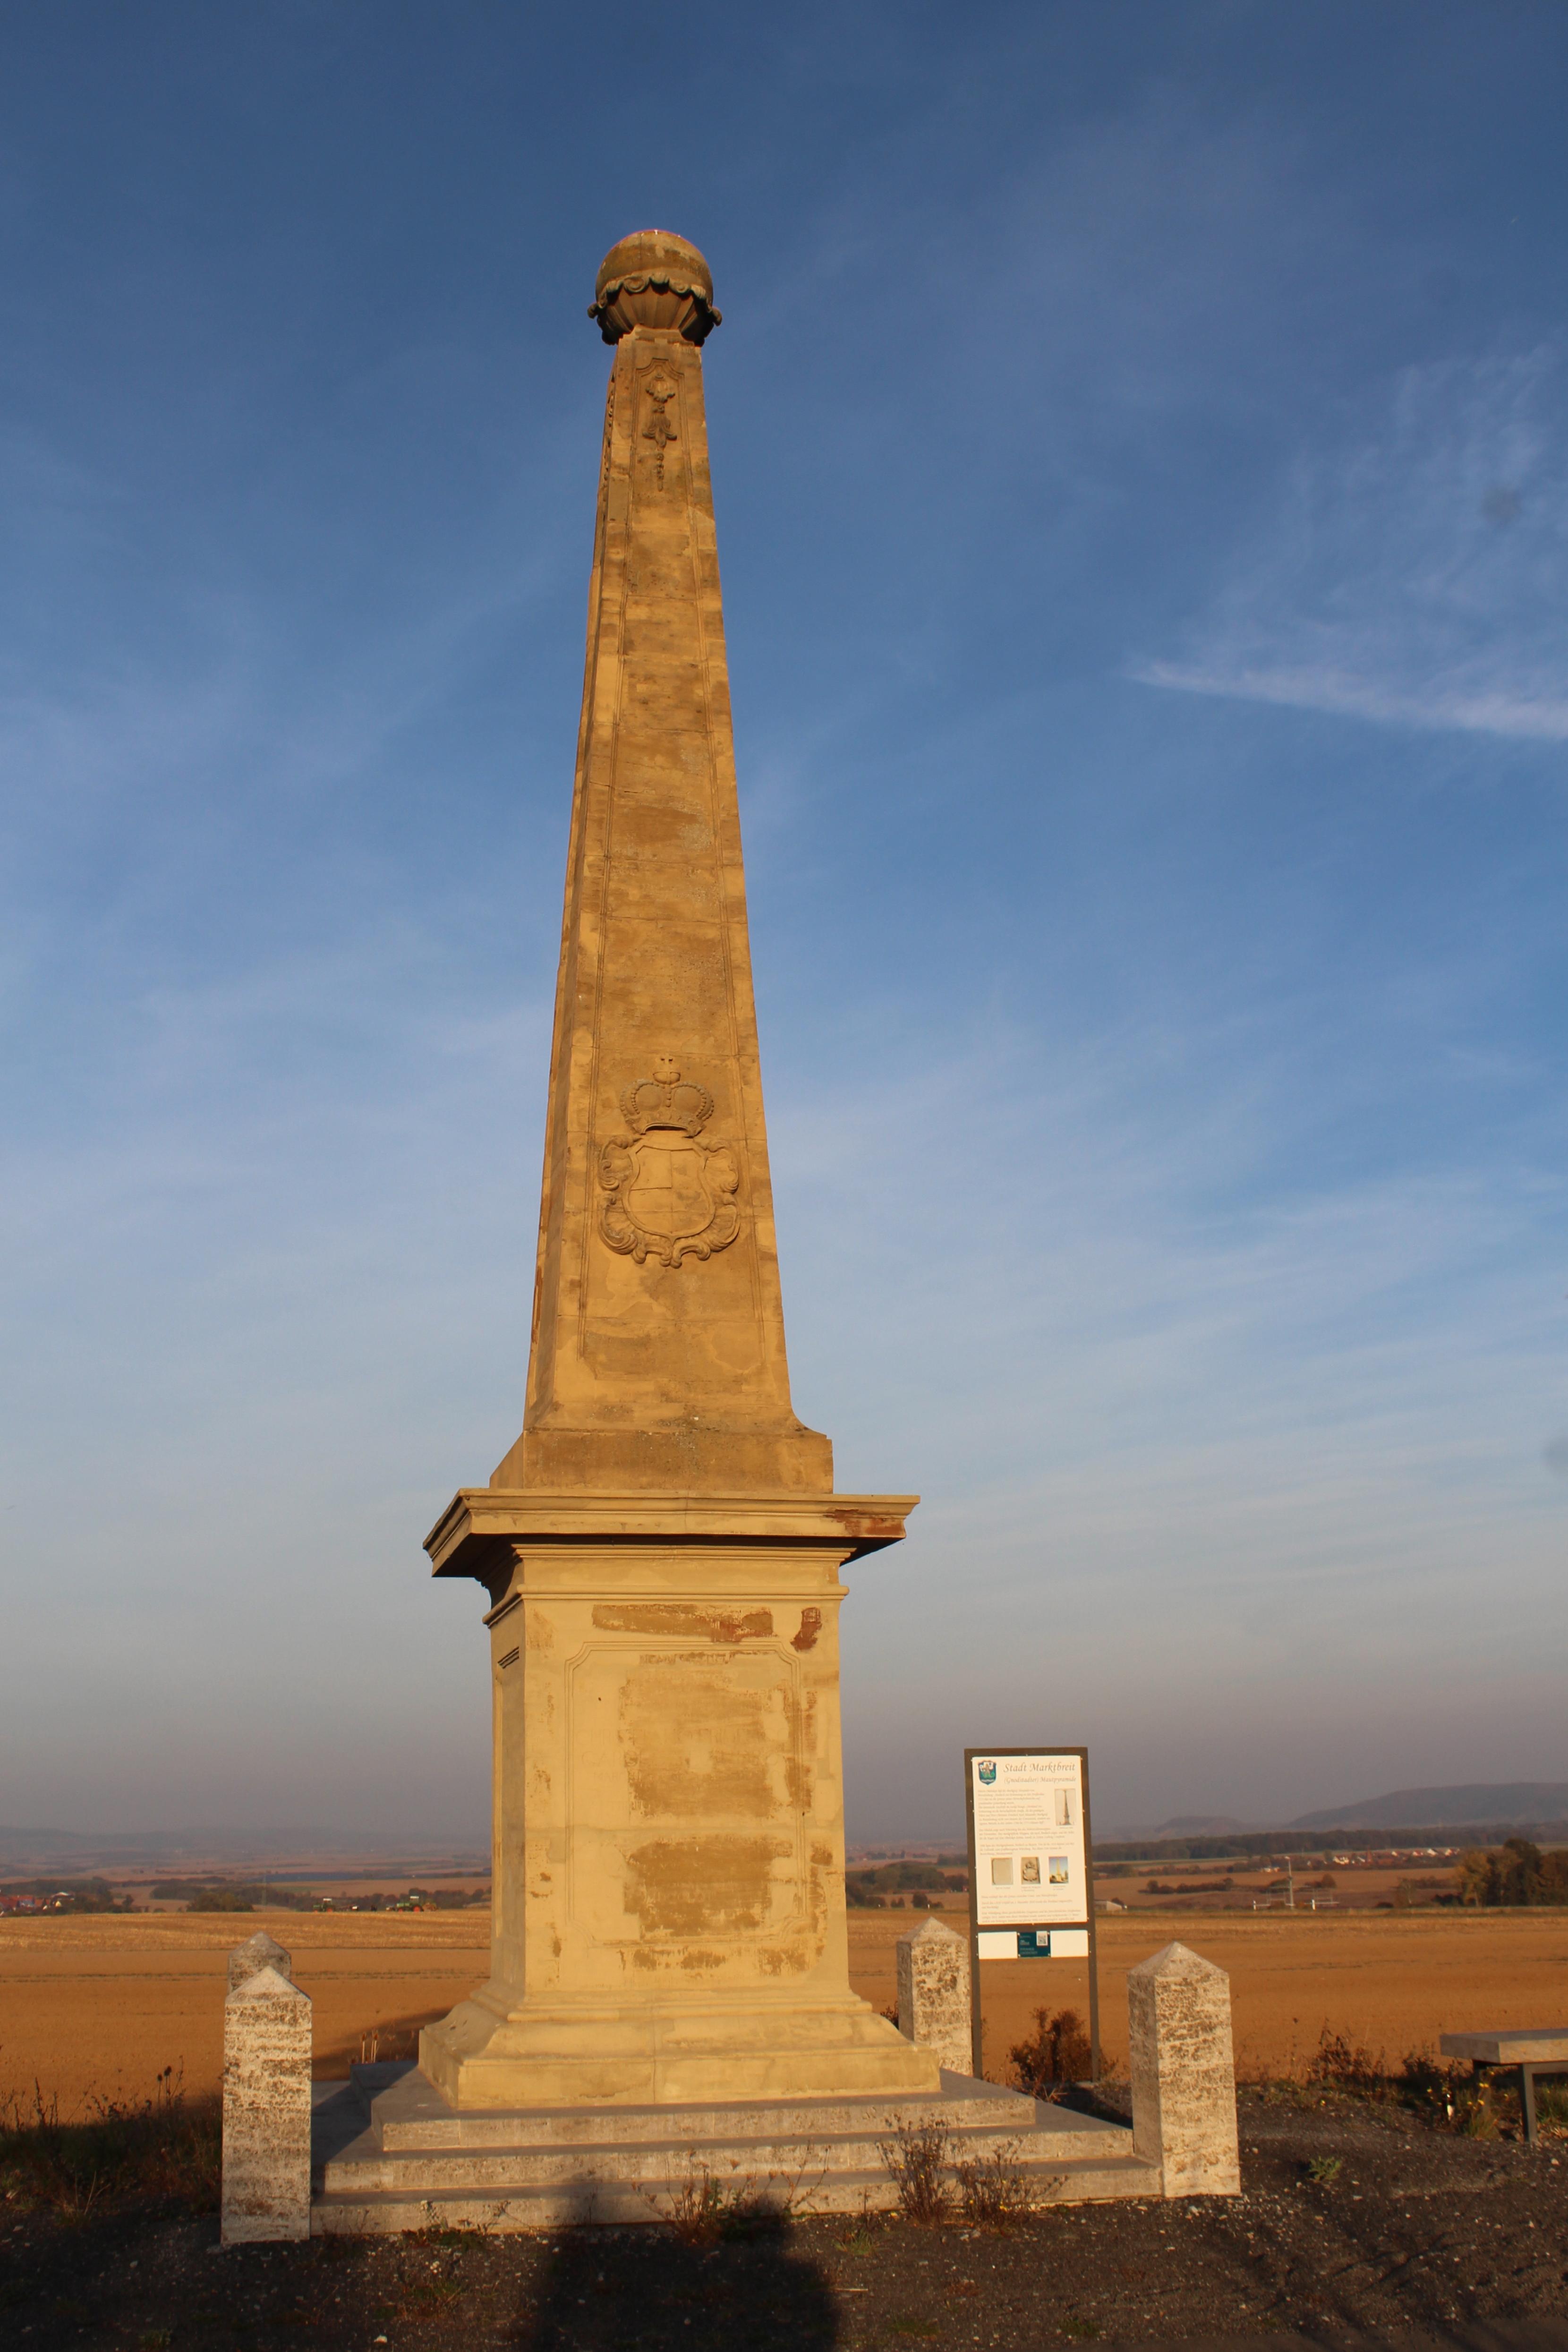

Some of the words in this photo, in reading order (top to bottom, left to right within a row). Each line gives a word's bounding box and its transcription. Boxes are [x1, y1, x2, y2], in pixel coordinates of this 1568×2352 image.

[1004, 1762, 1026, 1773] Stadt
[1030, 1762, 1075, 1773] Marktbreit
[1040, 1775, 1076, 1783] Mautpyramide
